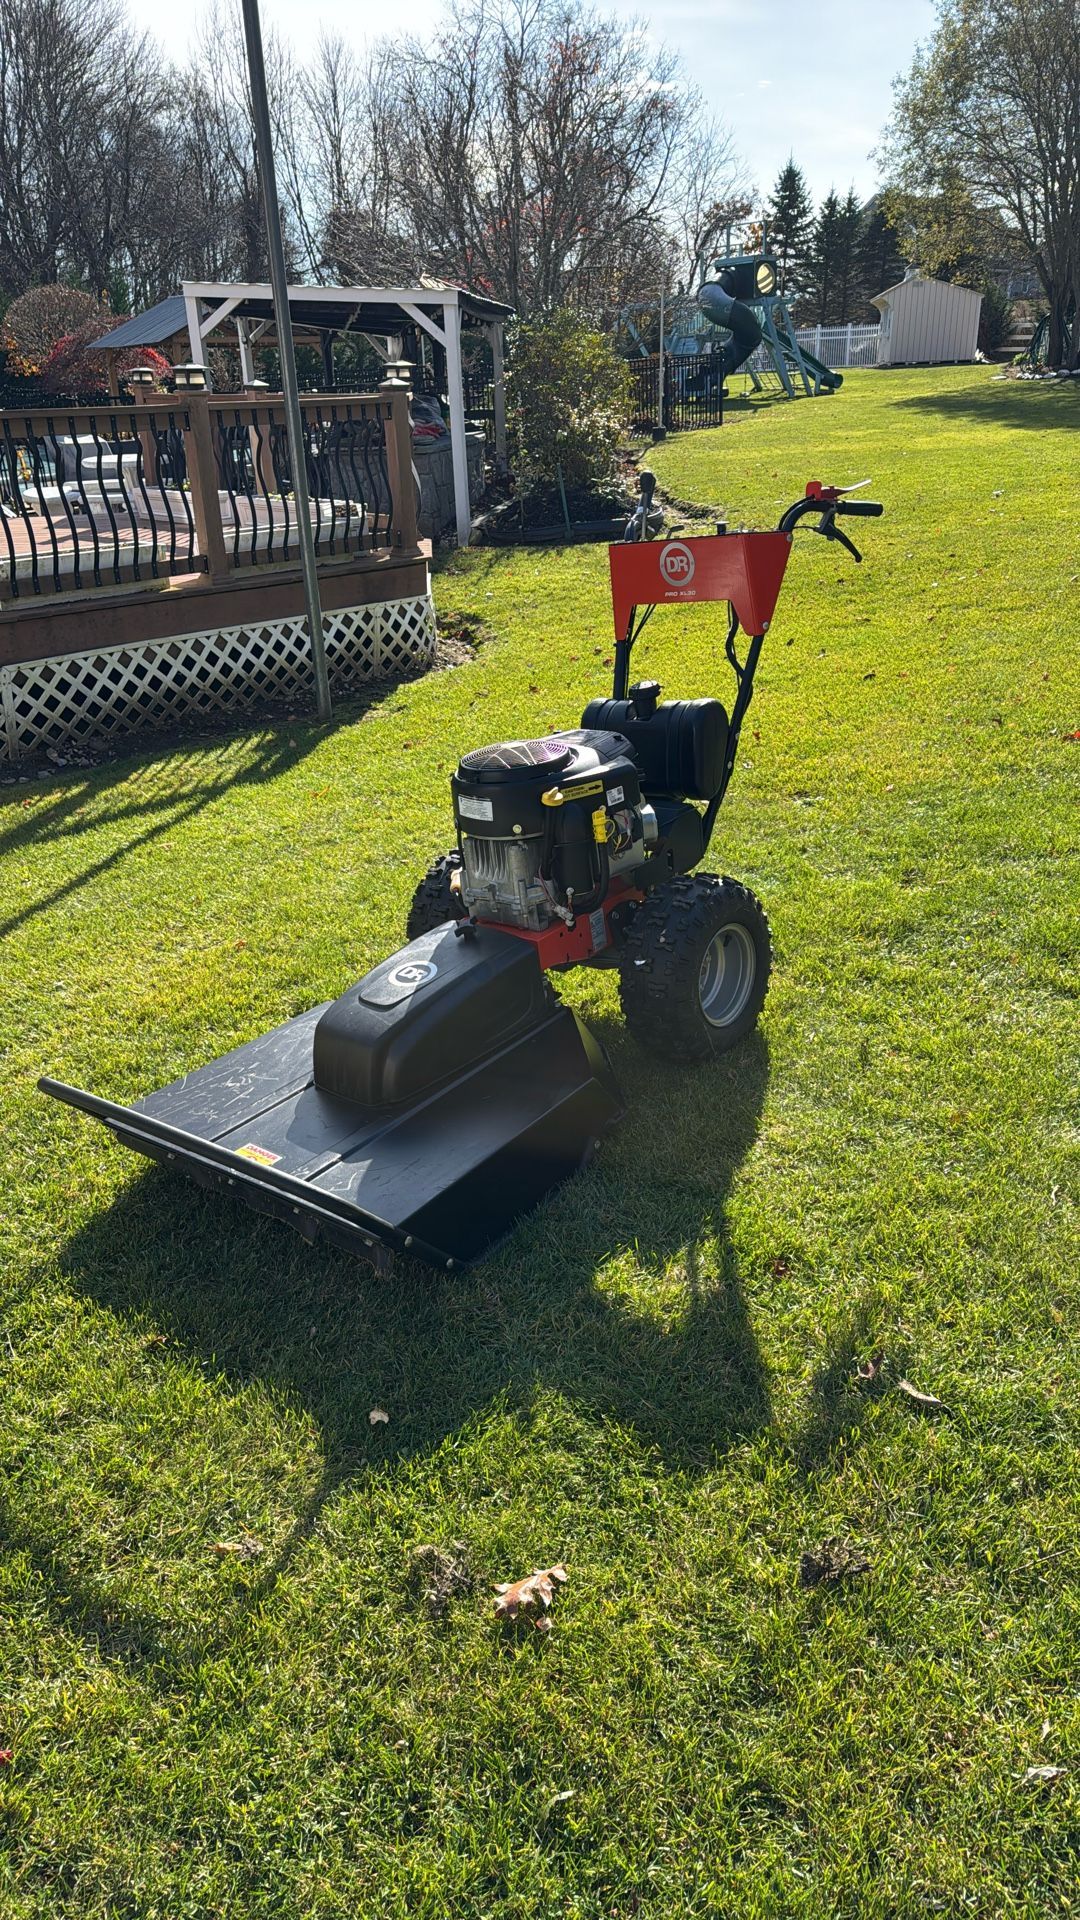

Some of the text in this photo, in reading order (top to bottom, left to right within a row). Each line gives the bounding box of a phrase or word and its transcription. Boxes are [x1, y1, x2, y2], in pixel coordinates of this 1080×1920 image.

[666, 555, 689, 573] DR
[397, 966, 429, 981] DR
[246, 1145, 279, 1161] DANGER
